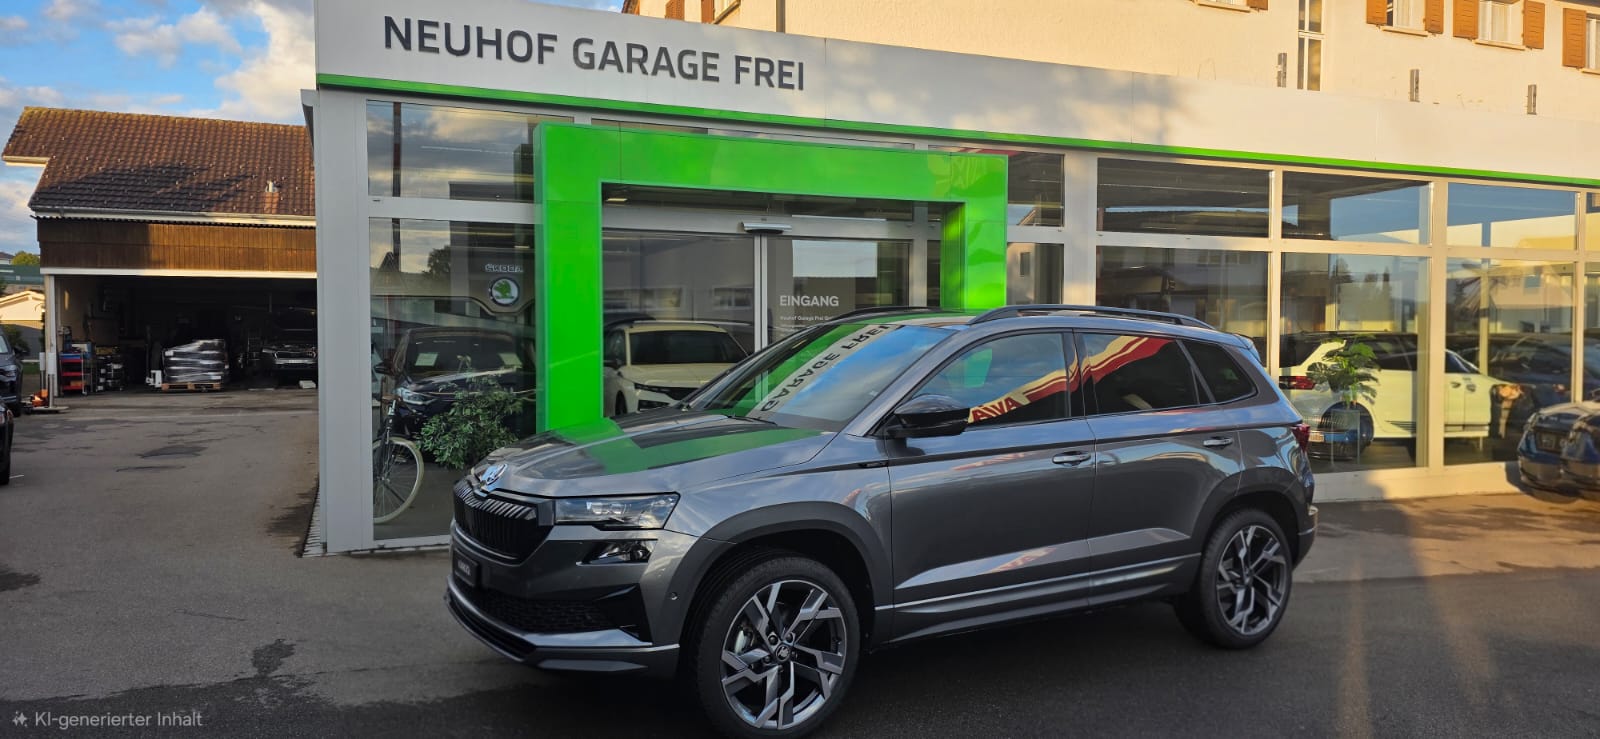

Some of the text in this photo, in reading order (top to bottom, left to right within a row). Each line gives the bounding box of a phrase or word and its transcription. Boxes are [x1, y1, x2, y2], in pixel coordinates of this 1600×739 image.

[384, 15, 804, 91] NEUHOF GARAGE FREI
[779, 295, 839, 307] EINGANG
